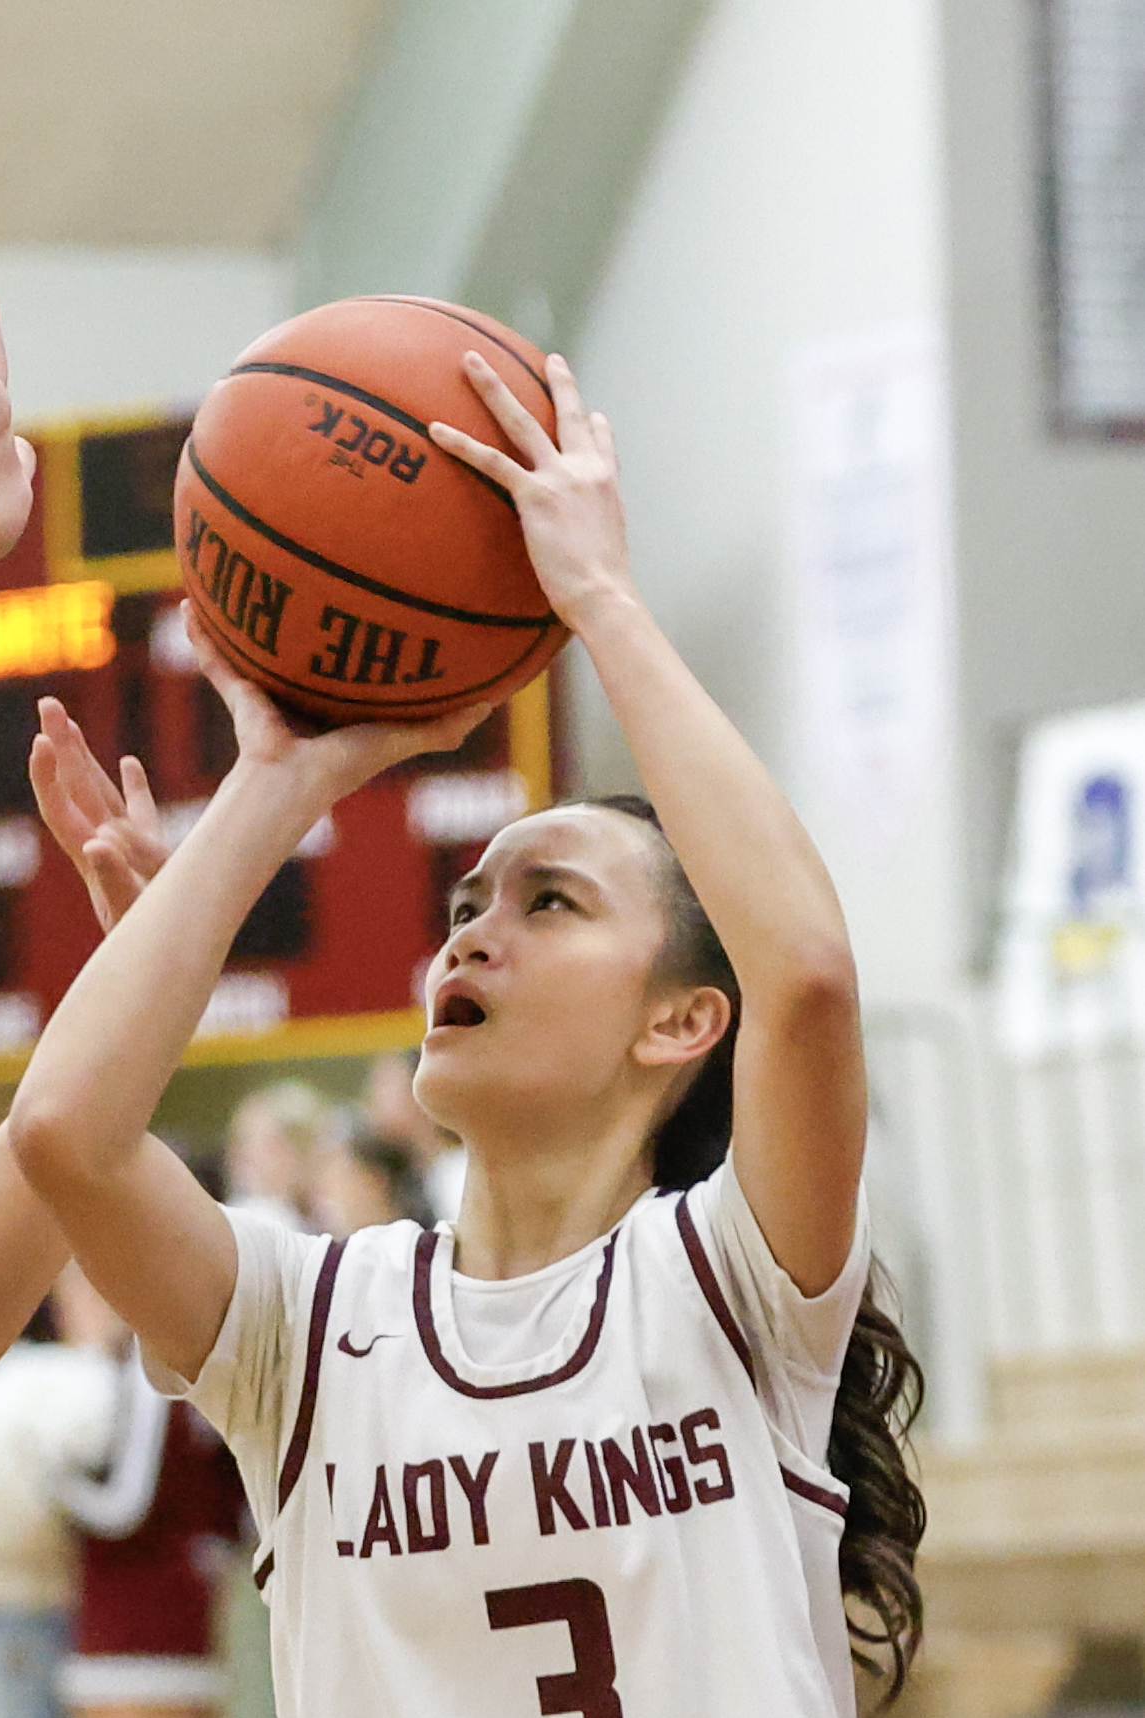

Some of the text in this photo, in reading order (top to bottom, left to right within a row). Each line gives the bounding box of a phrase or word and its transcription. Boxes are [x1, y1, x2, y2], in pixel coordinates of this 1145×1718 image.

[308, 400, 427, 485] ROCK
[186, 507, 295, 657] ROCK
[310, 603, 446, 685] THE
[528, 1407, 735, 1536] KINGS
